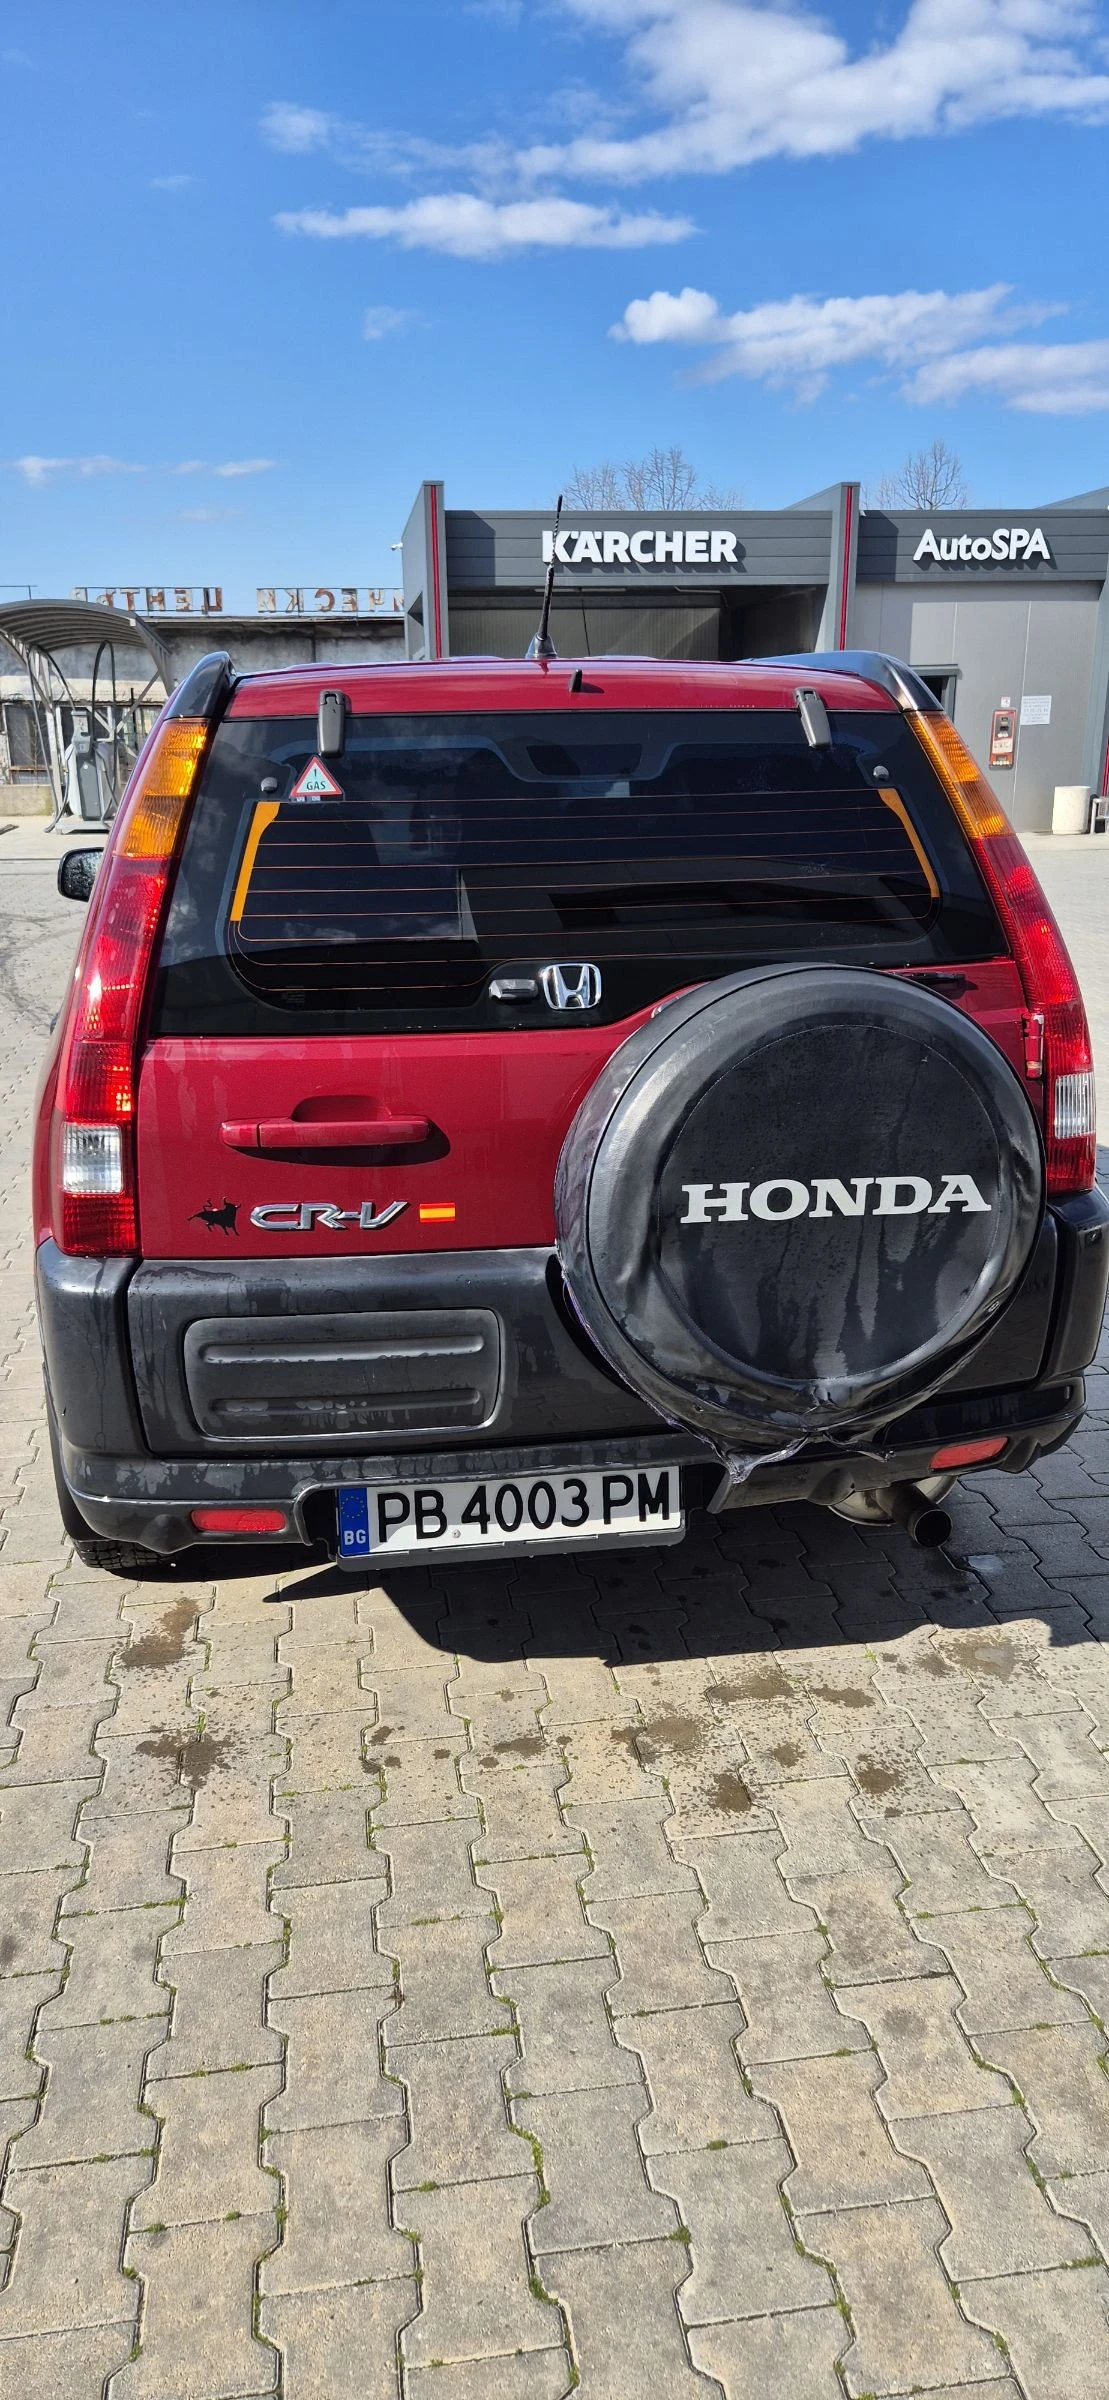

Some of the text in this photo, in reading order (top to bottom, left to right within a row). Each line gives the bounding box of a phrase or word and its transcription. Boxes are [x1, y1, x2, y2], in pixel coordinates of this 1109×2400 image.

[542, 530, 738, 563] KÄRCHER
[913, 528, 1050, 562] AutoSPA
[306, 780, 326, 790] GAS
[680, 1174, 992, 1223] HONDA
[250, 1201, 407, 1231] CR-V
[377, 1471, 669, 1543] PB 4003 PM
[344, 1530, 366, 1545] BG
